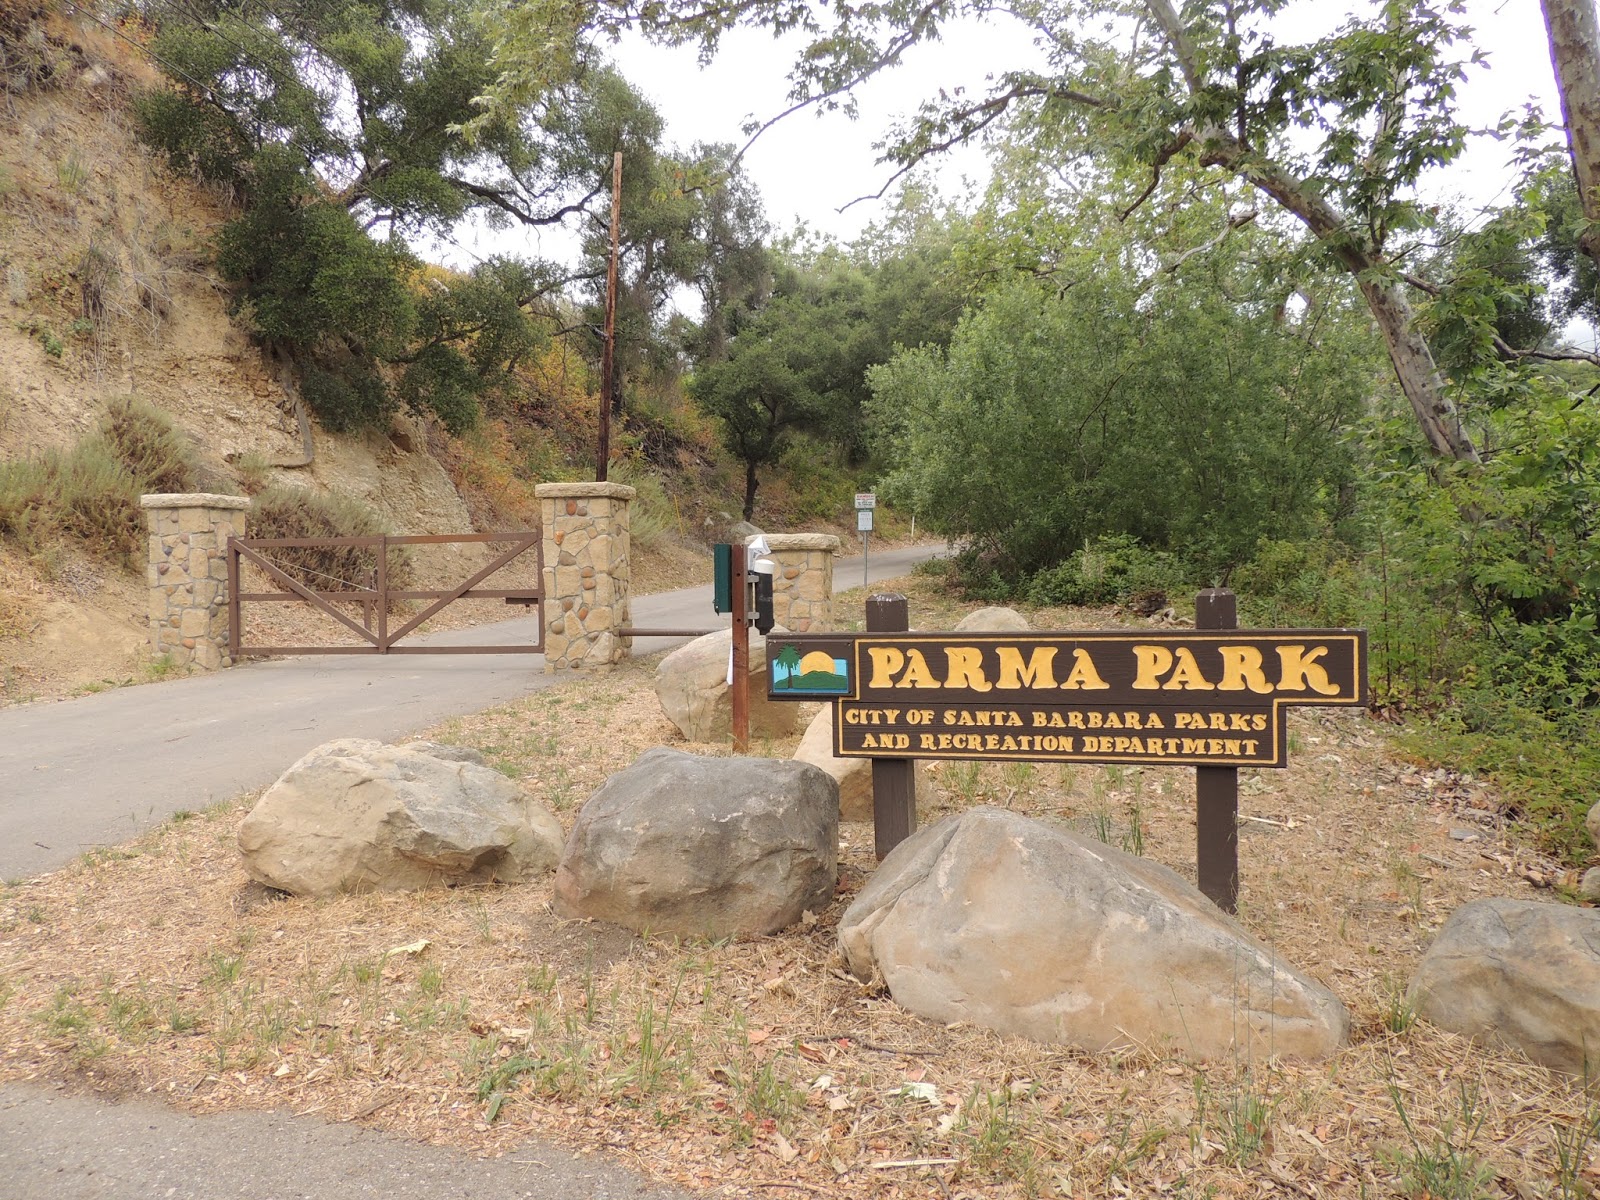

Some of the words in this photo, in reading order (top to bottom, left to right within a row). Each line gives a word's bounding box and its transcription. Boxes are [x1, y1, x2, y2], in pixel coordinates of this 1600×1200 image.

[868, 647, 1110, 692] PARMA
[1132, 645, 1340, 695] PARK
[846, 709, 900, 724] CITY
[906, 709, 935, 725] OF
[943, 710, 1023, 726] SANTA
[1032, 711, 1164, 729] BARBARA
[1175, 713, 1267, 731] PARKS
[863, 733, 909, 749] AND
[920, 734, 1073, 751] RECREATION
[1082, 736, 1258, 755] DEPARTMENT
